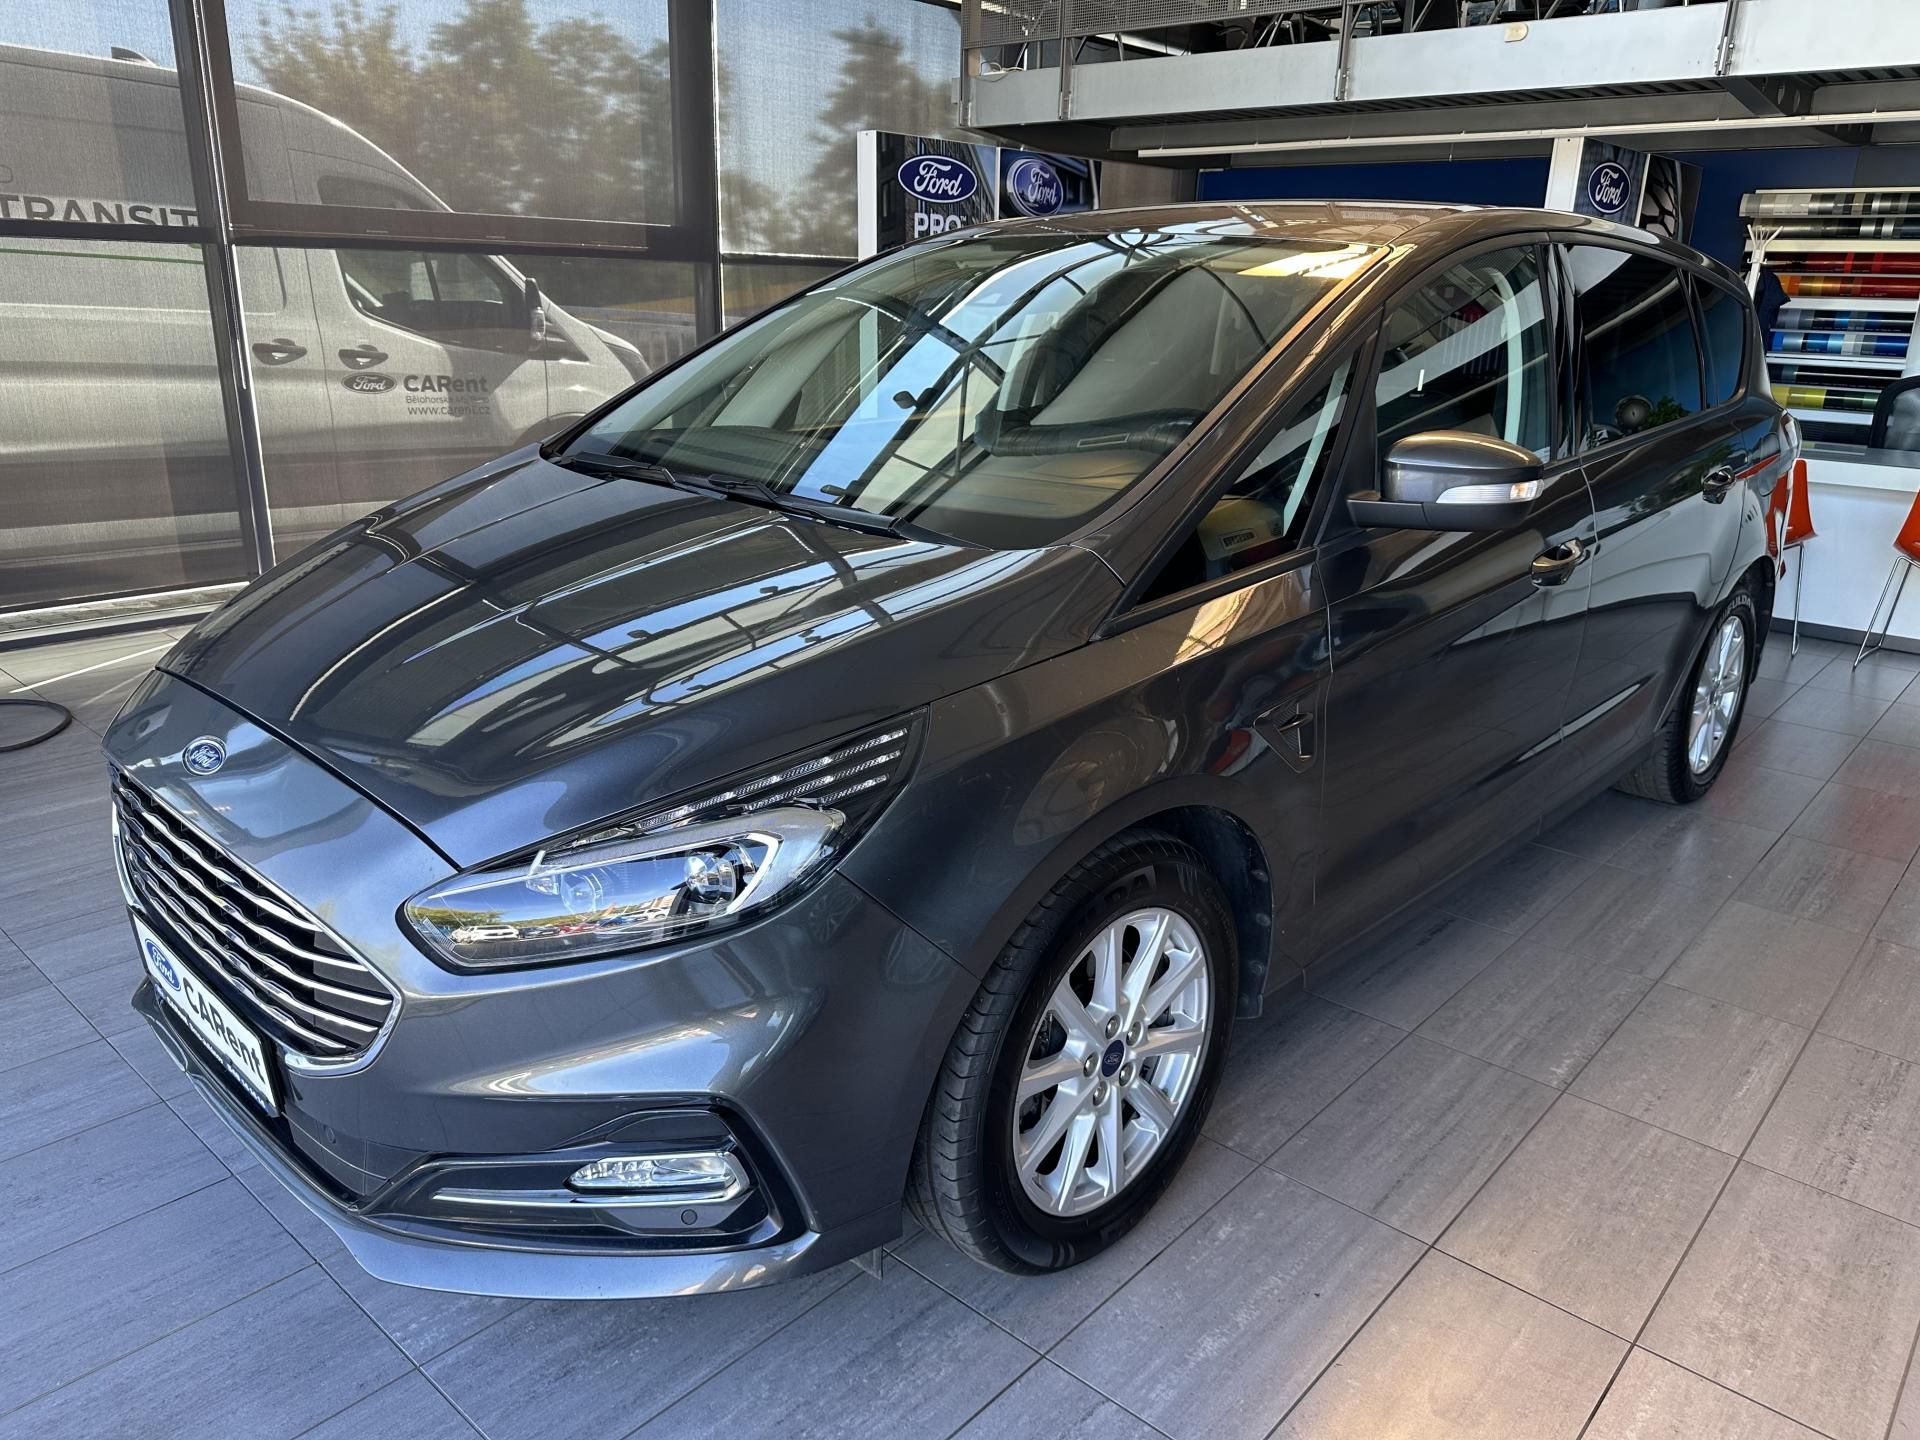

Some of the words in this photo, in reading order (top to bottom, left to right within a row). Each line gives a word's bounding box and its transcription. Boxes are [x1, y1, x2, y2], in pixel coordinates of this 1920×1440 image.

[914, 161, 963, 196] Ford
[0, 193, 200, 227] TRANSIT
[403, 374, 489, 393] CARent
[182, 976, 266, 1085] CARent
